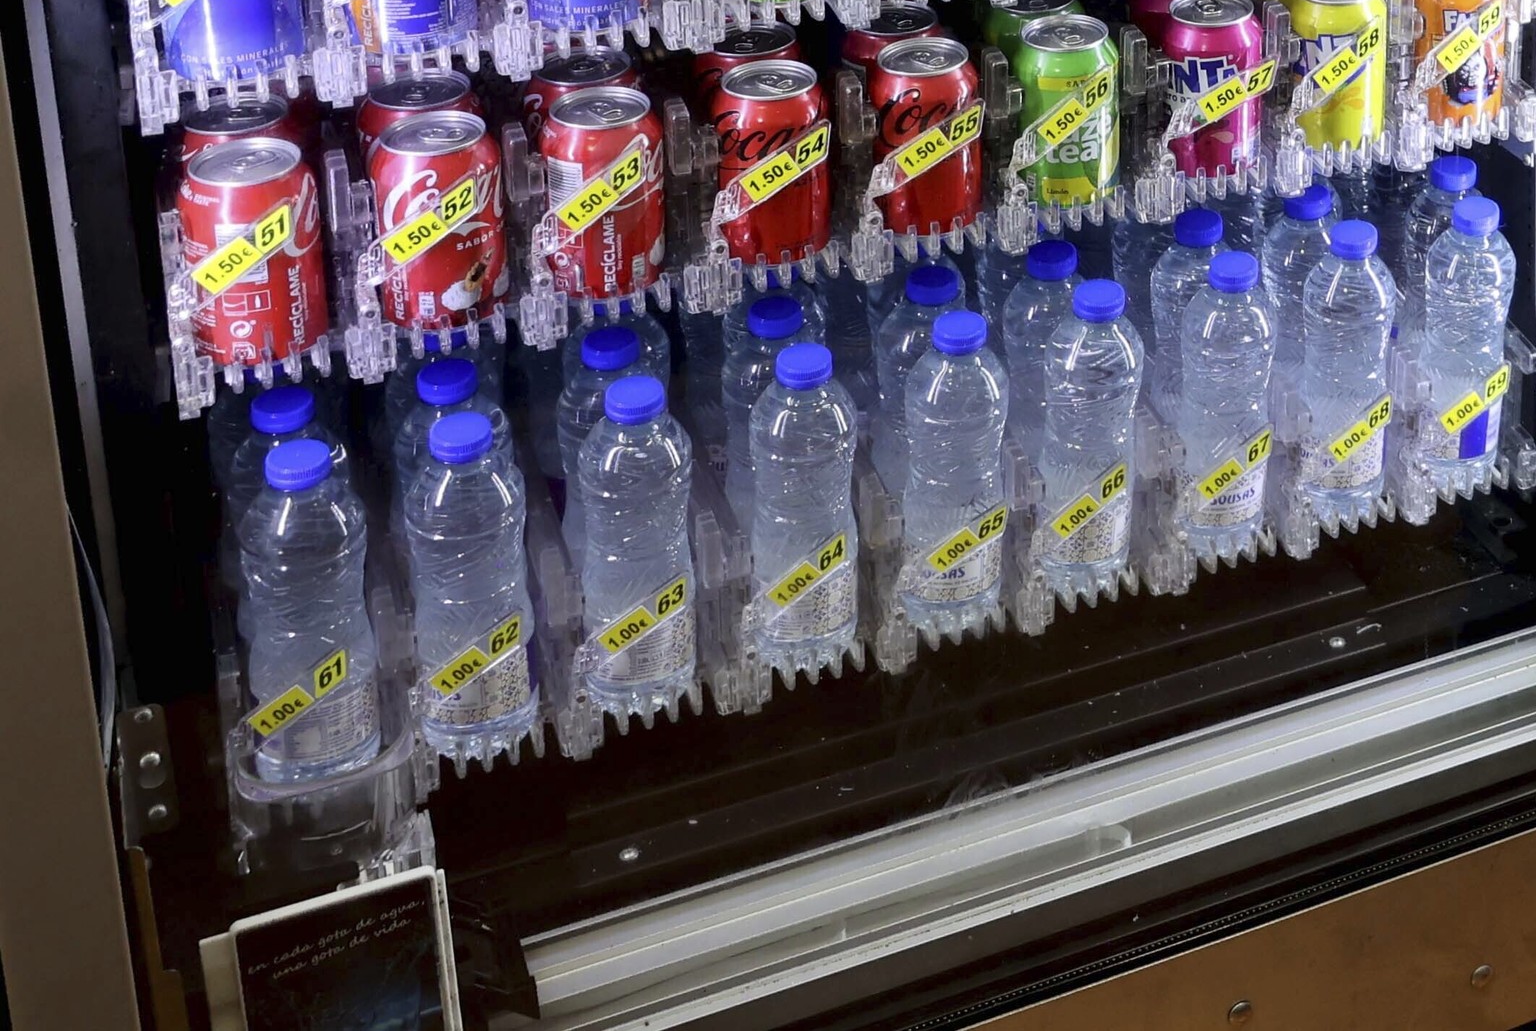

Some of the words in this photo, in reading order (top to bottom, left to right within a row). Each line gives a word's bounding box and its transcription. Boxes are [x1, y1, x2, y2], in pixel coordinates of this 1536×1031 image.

[1481, 5, 1500, 34] 59
[1359, 29, 1379, 57] 58
[1247, 65, 1271, 93] 57
[1085, 81, 1108, 107] 56
[951, 112, 978, 140] 55
[799, 133, 824, 164] 54
[1044, 143, 1098, 163] tea
[613, 160, 639, 191] 53
[444, 186, 471, 220] 52
[260, 215, 286, 247] 51
[1486, 377, 1507, 397] 69
[1369, 403, 1389, 429] 68
[1249, 438, 1269, 463] 67
[1103, 470, 1124, 497] 66
[979, 511, 1004, 538] 65
[820, 541, 843, 569] 64
[658, 585, 683, 614] 63
[491, 622, 518, 653] 62
[319, 657, 342, 689] 61
